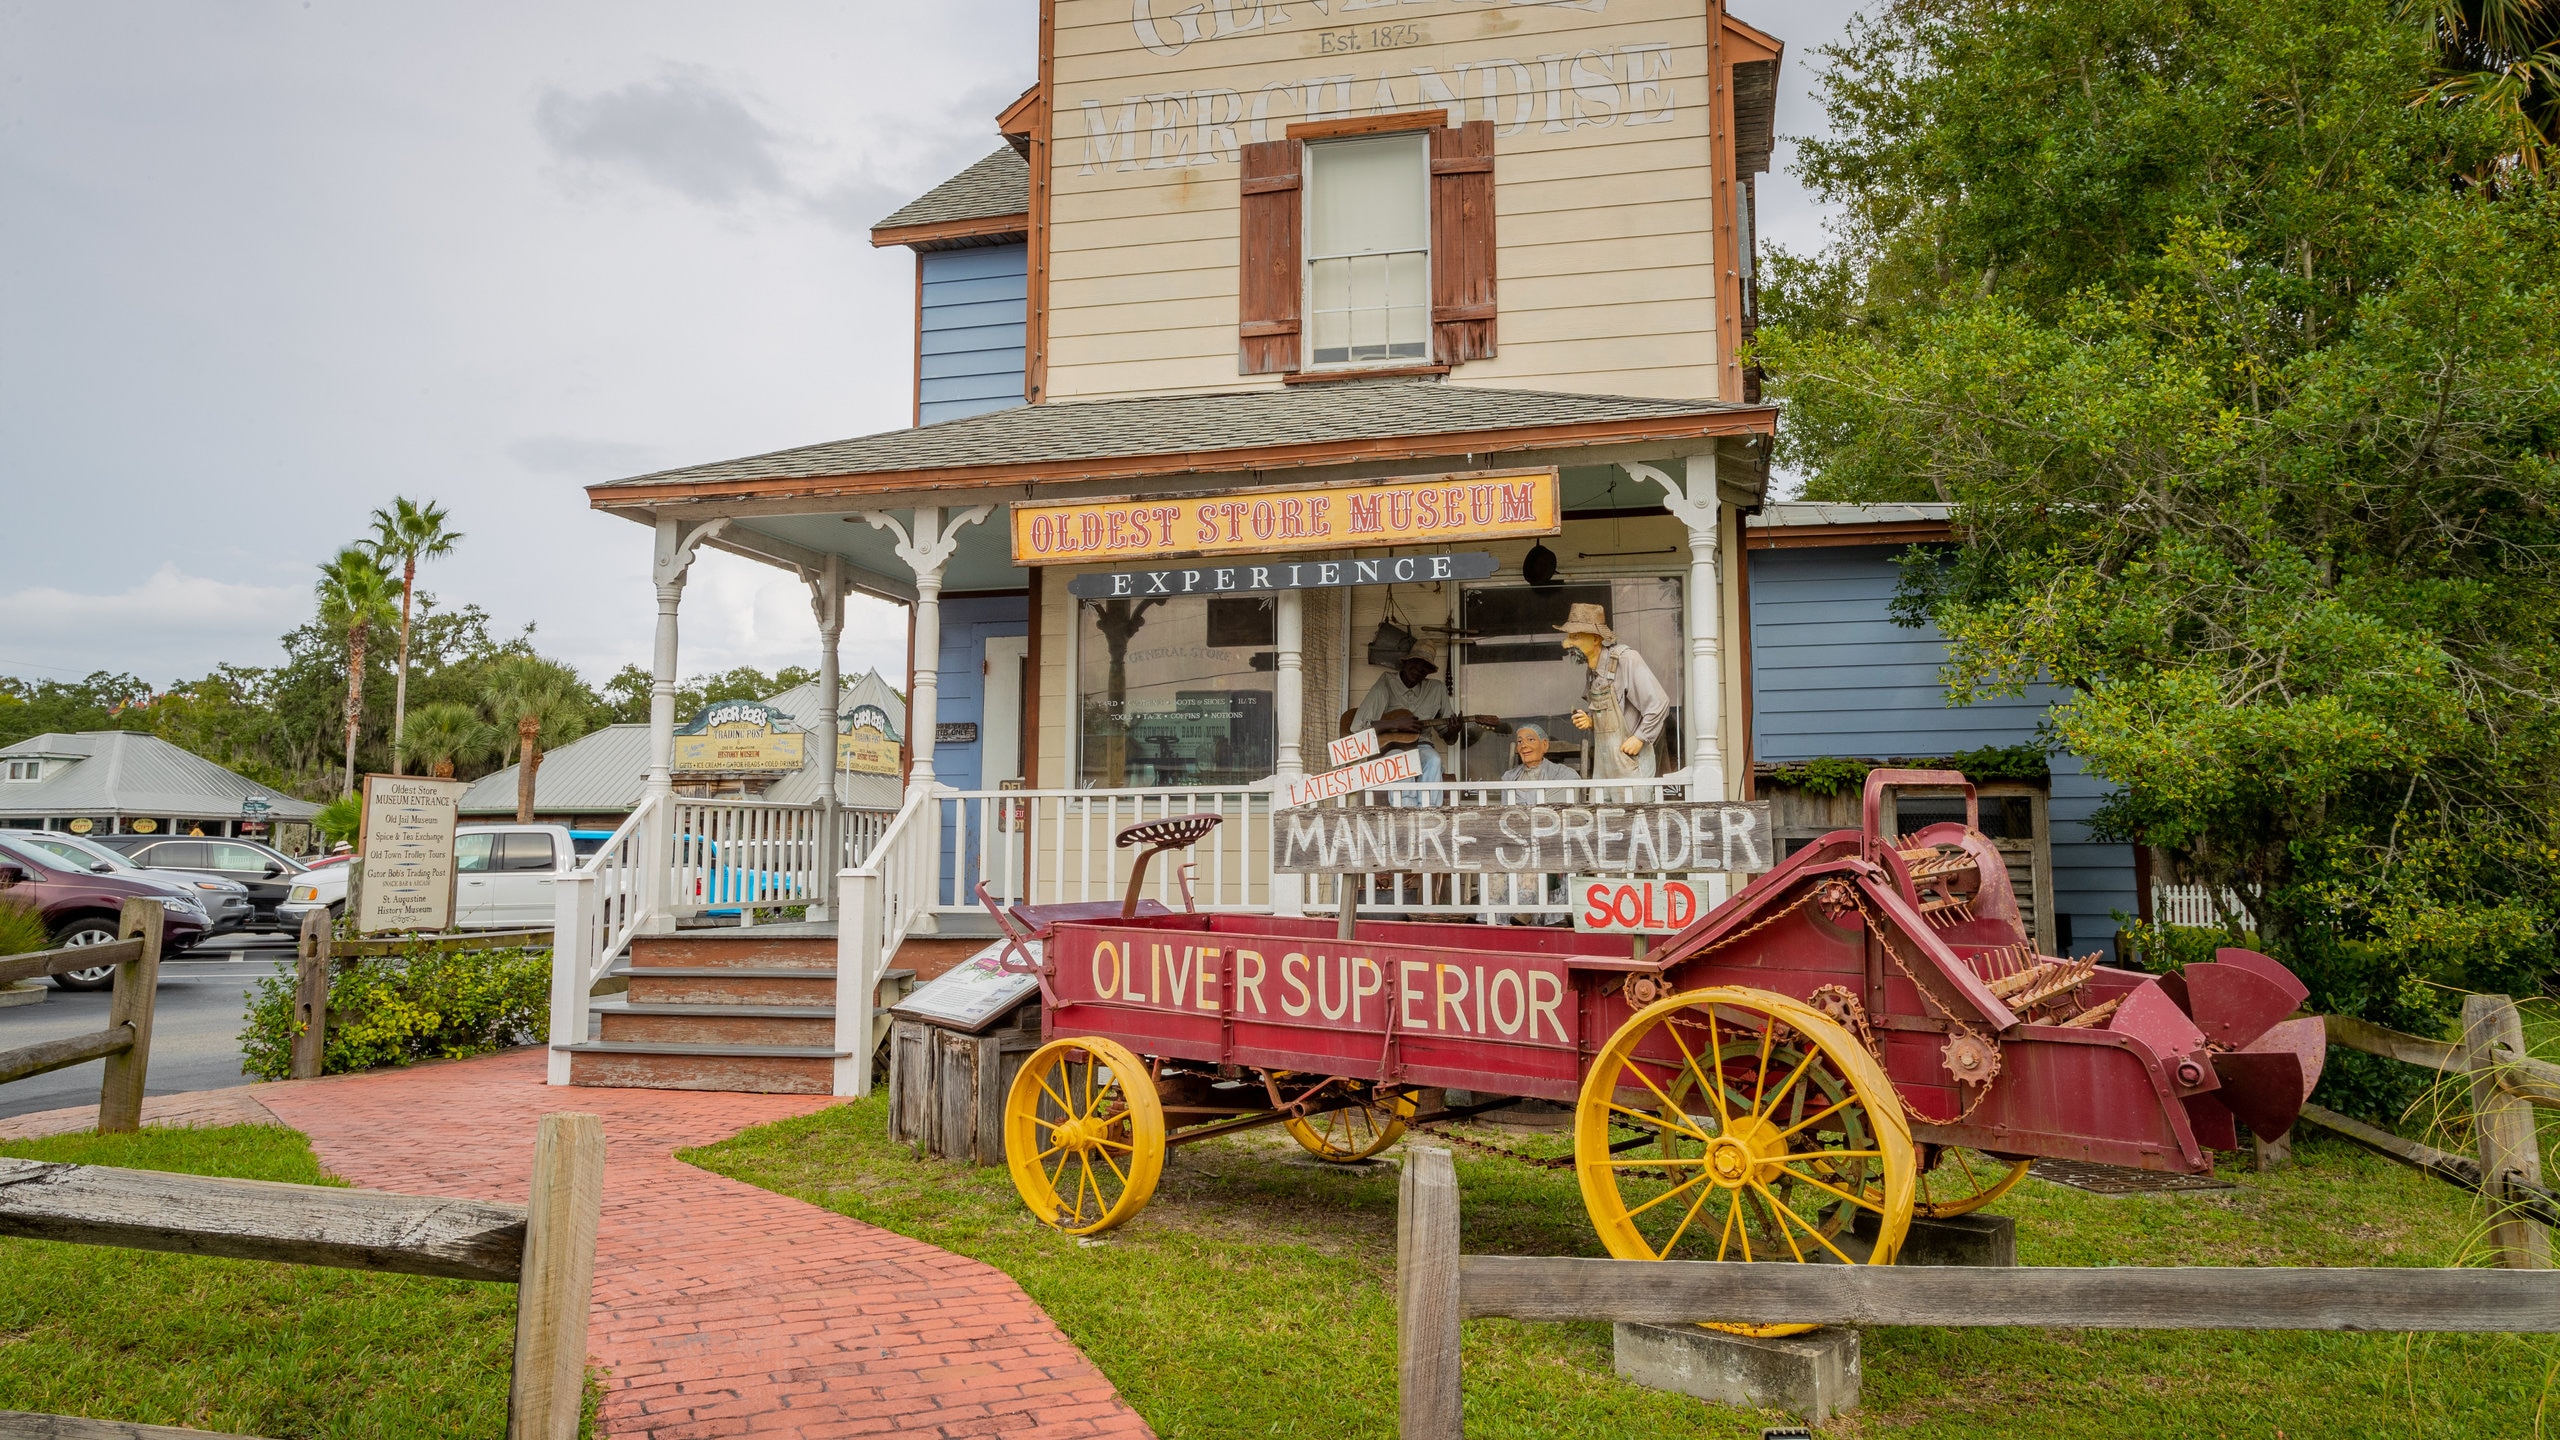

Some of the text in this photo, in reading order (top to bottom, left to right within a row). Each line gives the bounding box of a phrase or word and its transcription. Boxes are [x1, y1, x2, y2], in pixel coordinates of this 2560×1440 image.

[1319, 29, 1361, 54] Est.
[1370, 25, 1420, 49] 1875
[1078, 42, 1675, 176] MERCHANDISE
[1029, 481, 1537, 553] OLDEST STORE MUSEUM
[1111, 556, 1453, 596] EXPERIENCE
[1129, 647, 1188, 664] GENERAL
[708, 705, 768, 727] GATOR BOB'S
[1210, 711, 1244, 719] NOTIONS
[713, 729, 765, 739] TRADING POST
[1332, 734, 1371, 764] NEW
[1290, 754, 1417, 806] LATEST MODEL
[391, 783, 438, 795] Oldest Store
[375, 794, 450, 807] MUSEUM ENTRANCE
[385, 814, 438, 825] Old Jail Museum
[375, 831, 394, 843] Spice
[394, 832, 400, 841] &
[403, 832, 413, 841] Tea
[415, 831, 444, 843] Exchange
[1284, 806, 1762, 871] MANURE SPREADER
[370, 849, 446, 862] Old Town Trolley Tours
[367, 868, 446, 880] Gator Bob's Trading Post
[383, 894, 427, 906] St. Augustine
[1584, 881, 1698, 930] SOLD
[377, 905, 433, 915] History Museum
[1091, 940, 1571, 1043] OLIVER SUPERIOR
